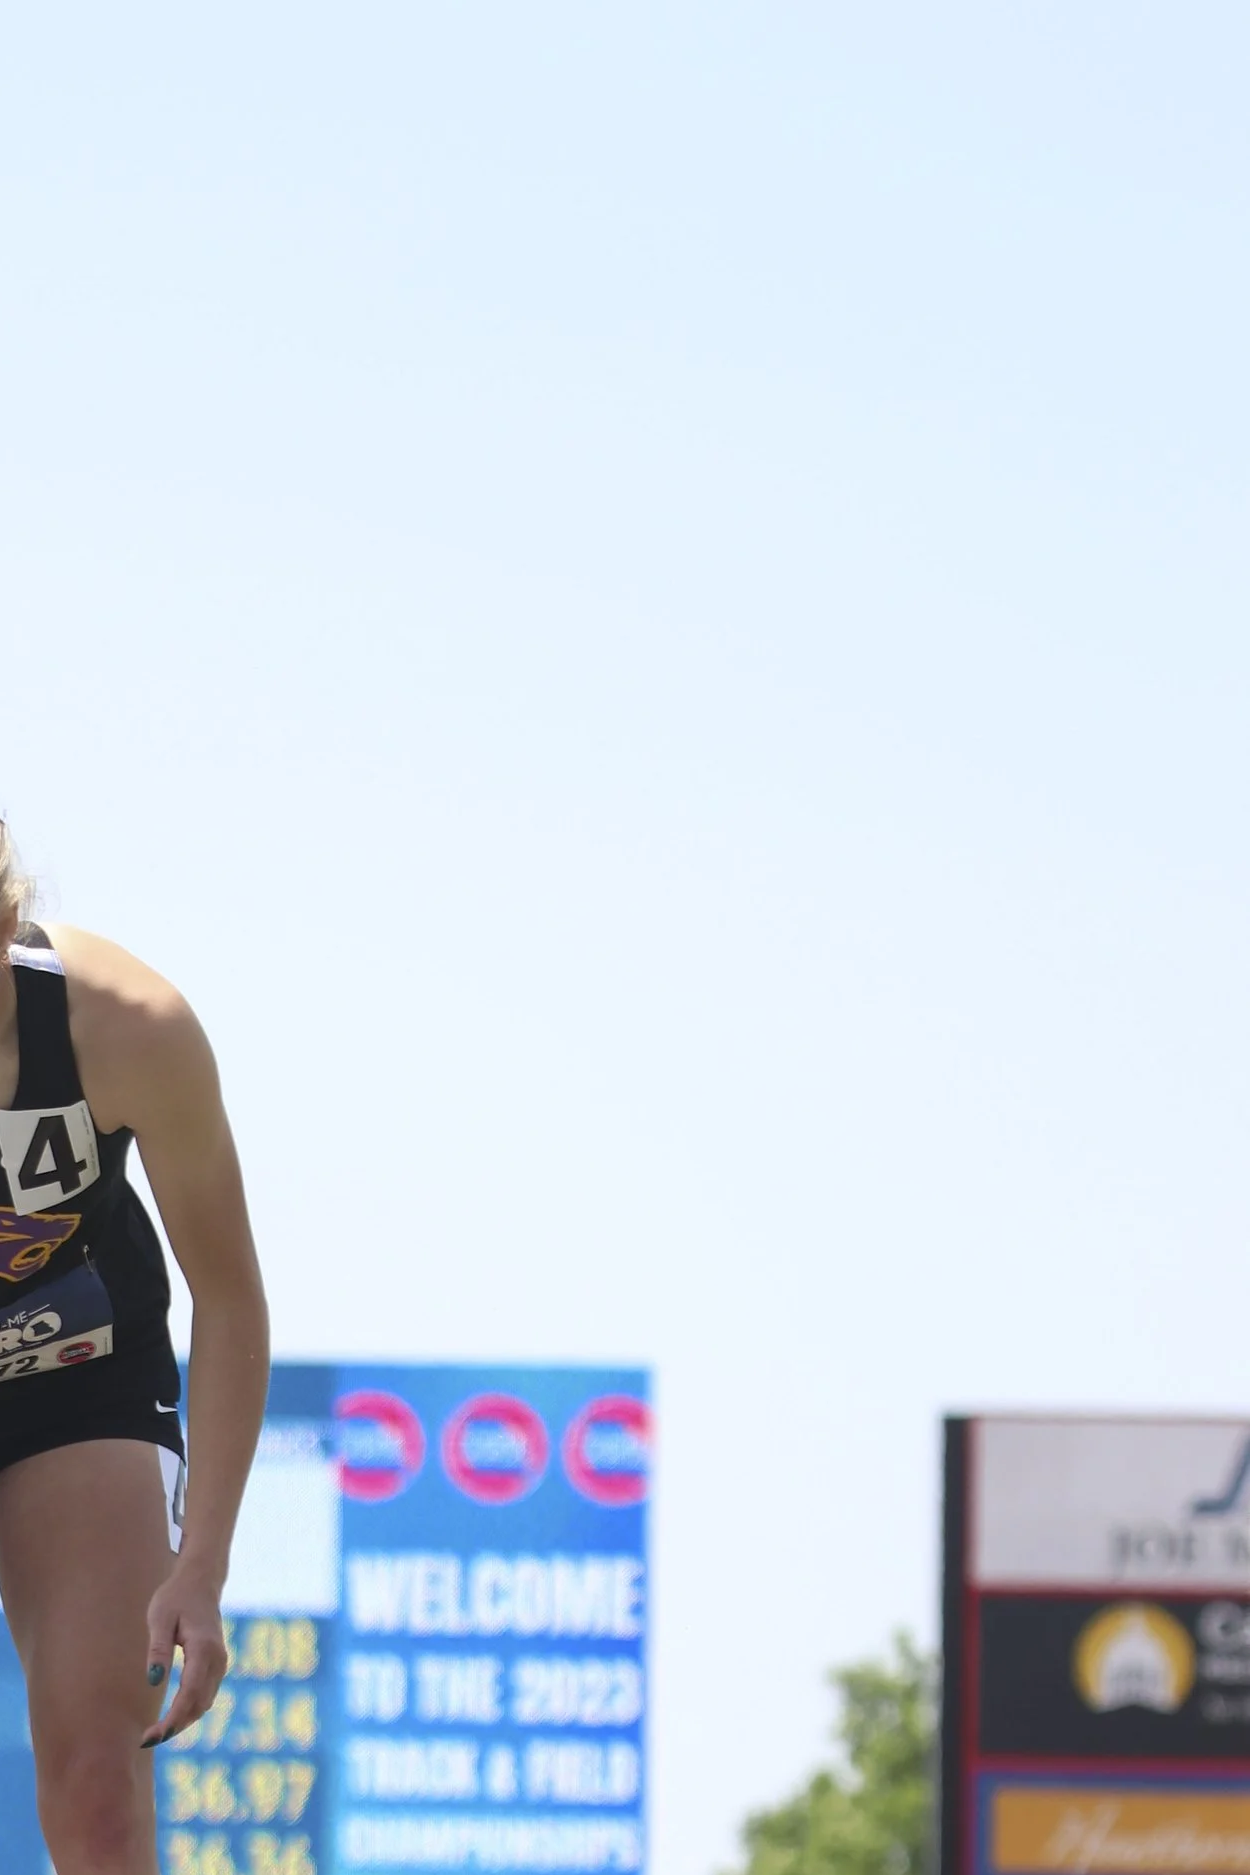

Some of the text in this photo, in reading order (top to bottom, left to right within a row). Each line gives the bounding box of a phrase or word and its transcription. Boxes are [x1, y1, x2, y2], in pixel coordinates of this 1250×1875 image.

[18, 1114, 88, 1195] 4
[346, 1553, 643, 1641] WELCOME
[414, 1653, 504, 1723] THE
[511, 1658, 642, 1727] 2023
